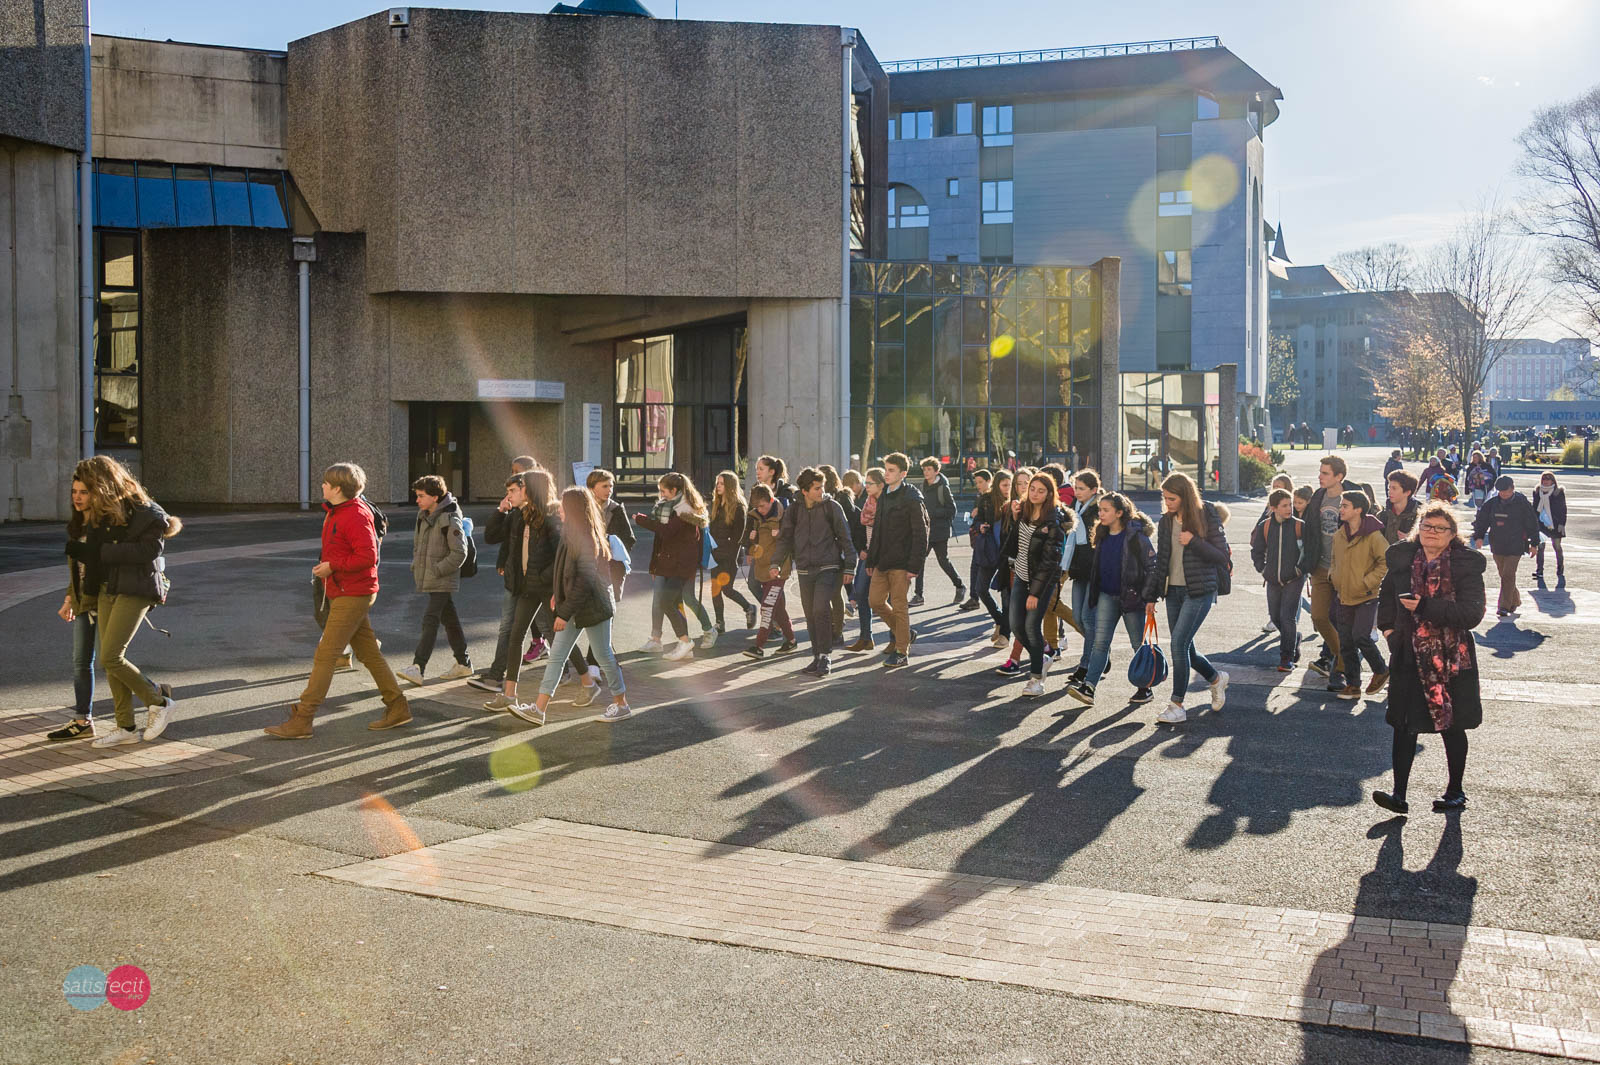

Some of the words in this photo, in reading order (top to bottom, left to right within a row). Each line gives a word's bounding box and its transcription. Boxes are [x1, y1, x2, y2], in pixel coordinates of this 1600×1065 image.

[1506, 411, 1545, 420] ACCUEIL
[1549, 411, 1600, 421] NOTRE-DA
[763, 585, 781, 606] NEW
[760, 606, 774, 629] YORK
